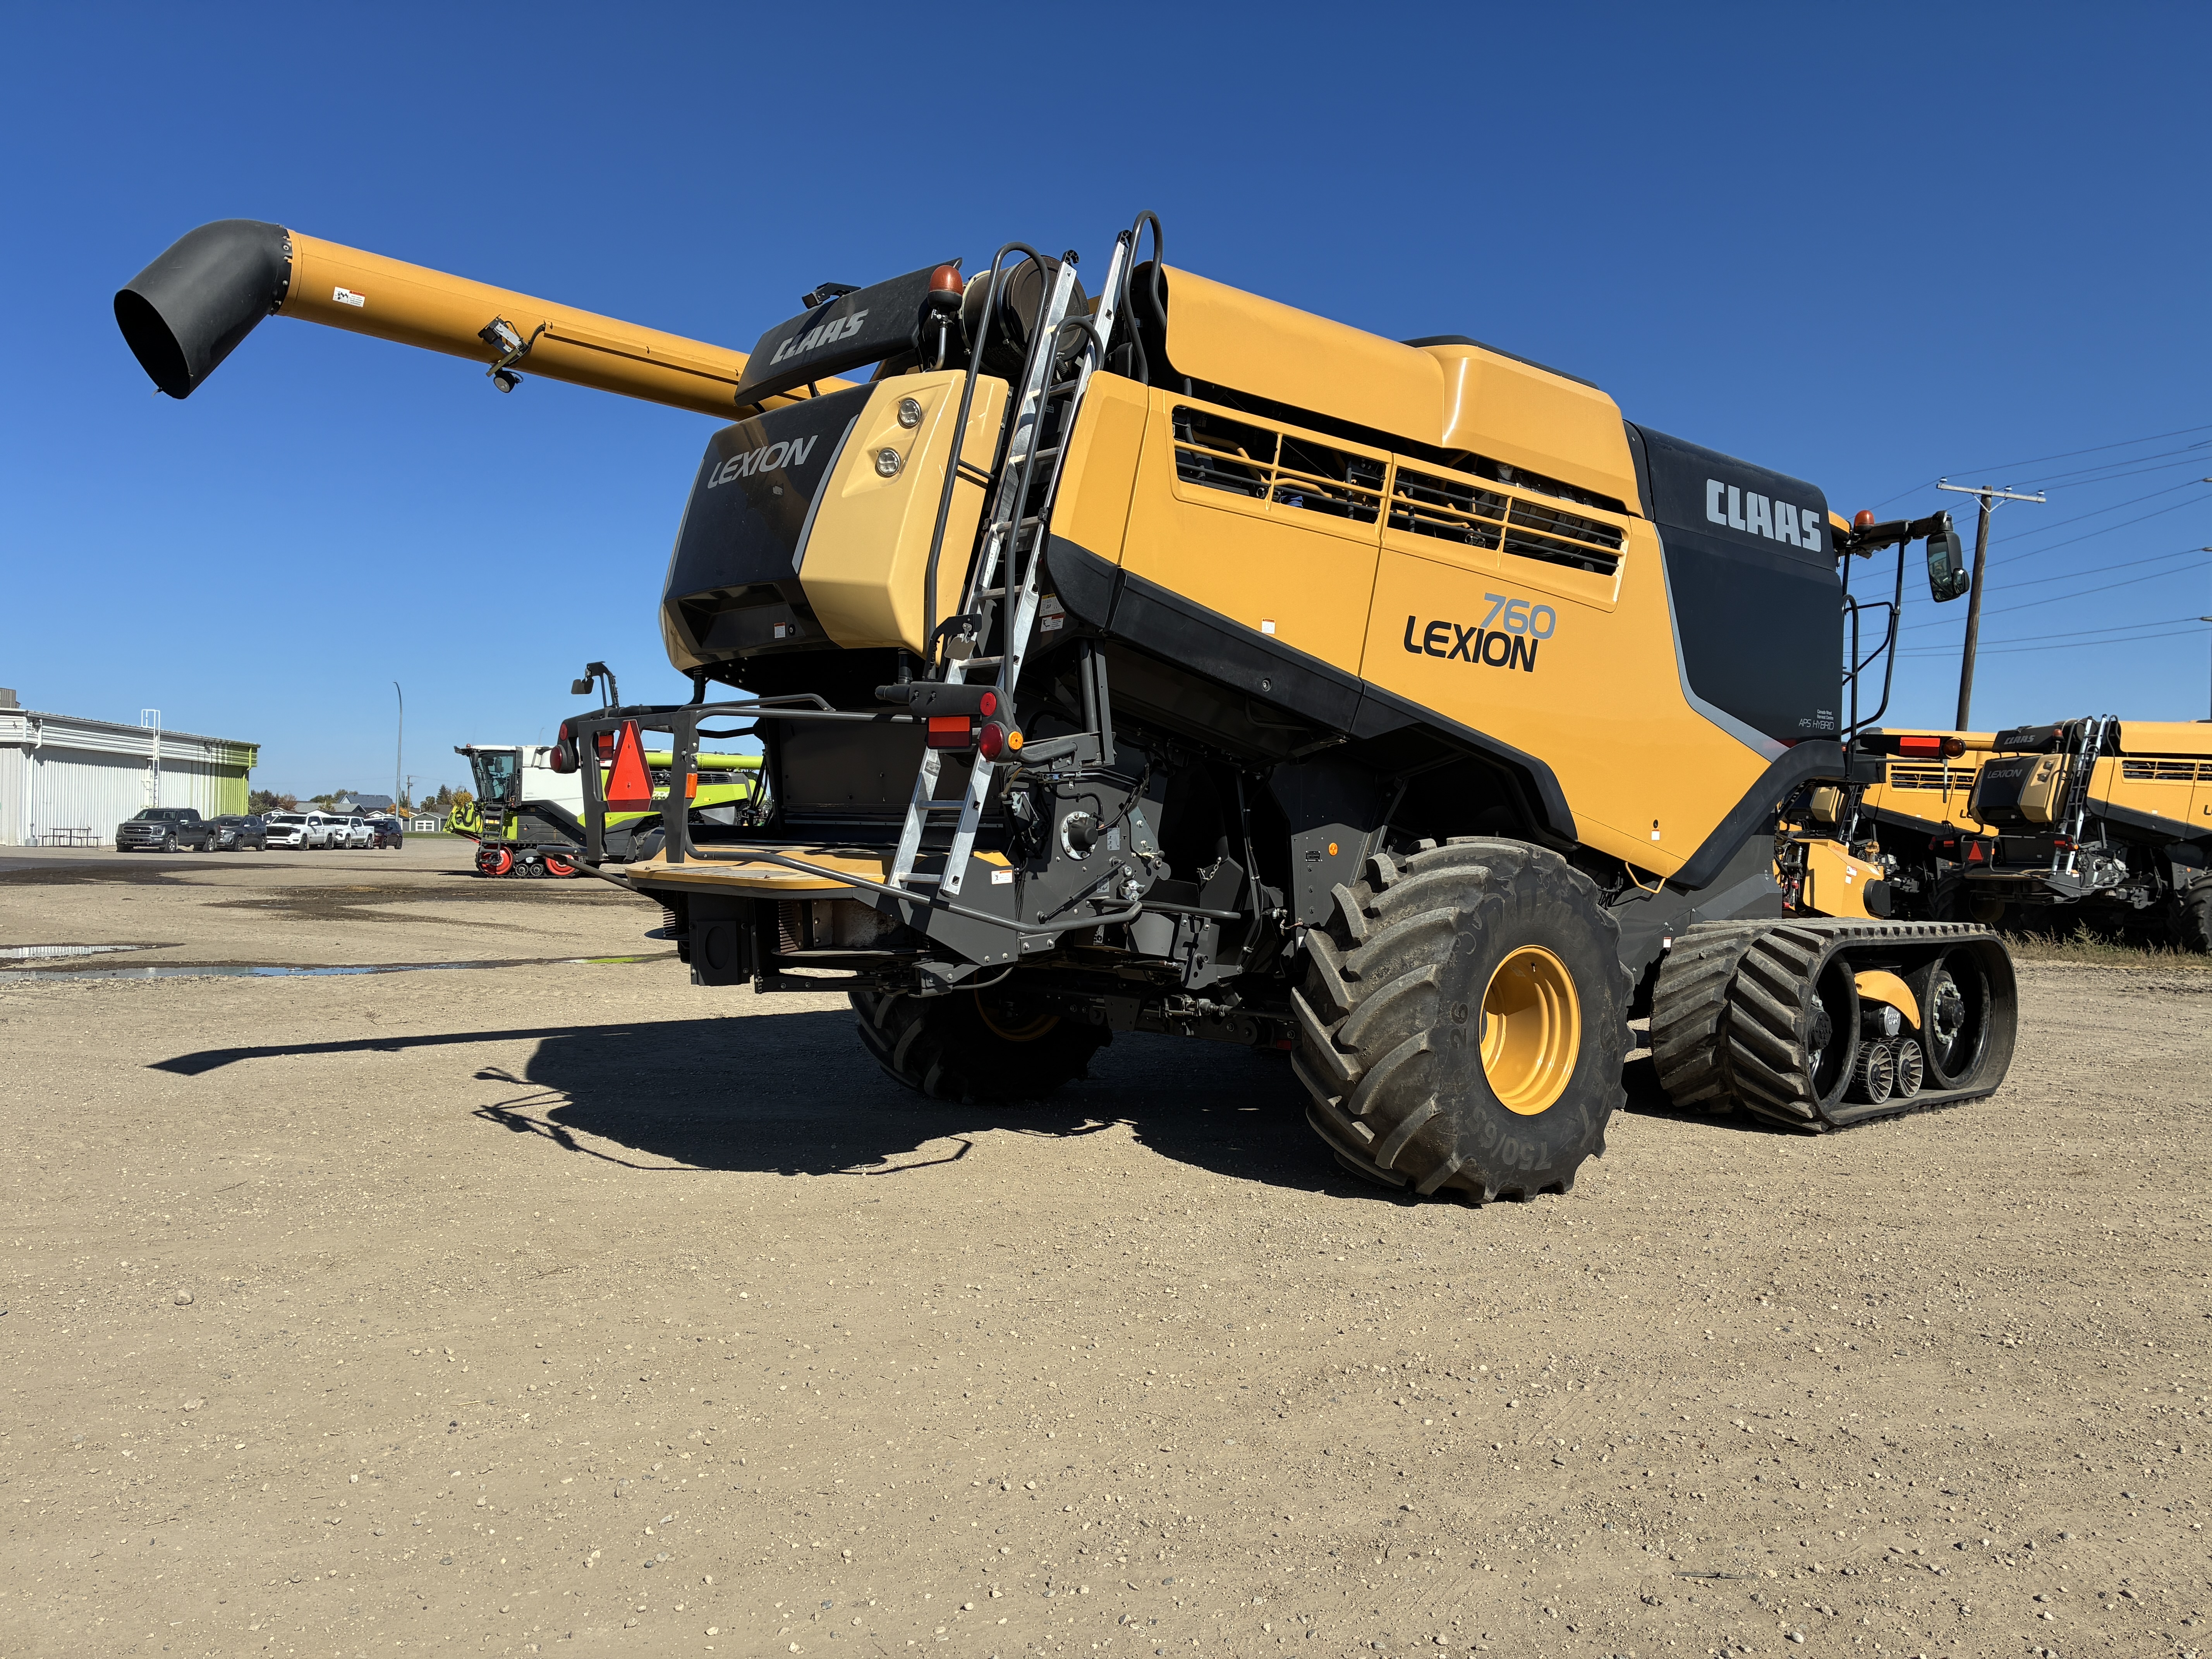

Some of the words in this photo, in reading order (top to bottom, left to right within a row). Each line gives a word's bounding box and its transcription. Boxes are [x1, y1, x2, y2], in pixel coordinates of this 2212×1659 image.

[770, 309, 869, 366] CLAAS
[707, 435, 818, 489] LEXION
[1707, 479, 1821, 552] CLAAS
[1480, 592, 1556, 639] 760
[1404, 615, 1538, 672] LEXION
[1798, 718, 1812, 728] APS
[1812, 720, 1834, 730] HYBRID
[2004, 735, 2035, 745] CLAAS
[1987, 769, 2023, 779] LEXION
[1449, 1001, 1468, 1049] 26
